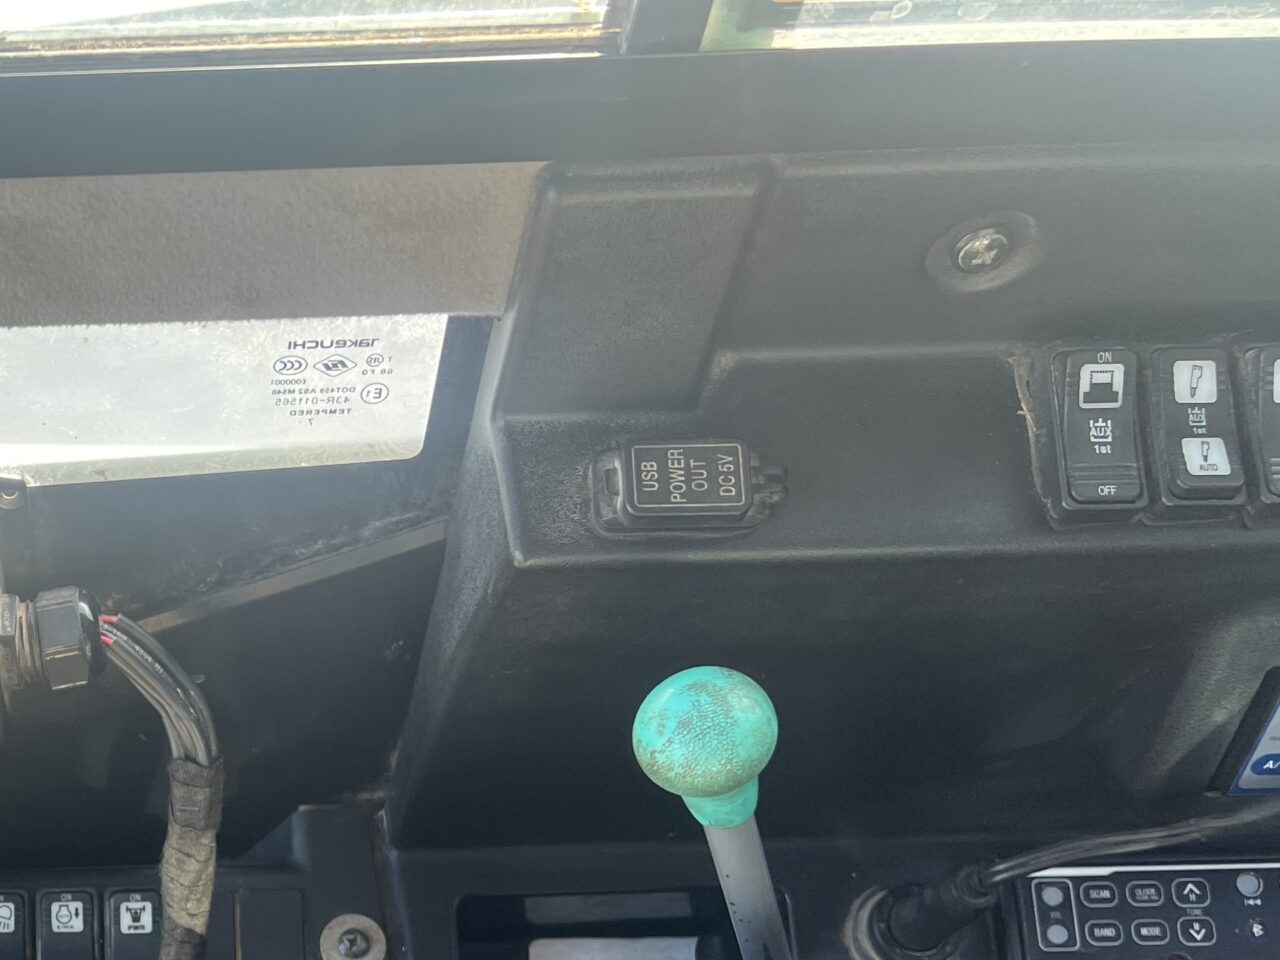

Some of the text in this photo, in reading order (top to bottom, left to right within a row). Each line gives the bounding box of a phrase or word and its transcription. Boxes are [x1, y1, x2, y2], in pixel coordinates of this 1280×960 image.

[1097, 351, 1112, 363] ON
[1188, 414, 1207, 422] AUX
[1089, 426, 1112, 437] AUX
[1093, 444, 1112, 454] 1st
[1199, 463, 1219, 472] AUTO
[640, 461, 659, 491] USB
[667, 448, 687, 503] POWER
[689, 459, 708, 491] OUT
[1097, 485, 1117, 496] OFF
[60, 893, 72, 901] ON
[129, 893, 141, 901] ON
[1088, 888, 1111, 899] SCAN
[1093, 927, 1116, 938] BAND
[1140, 926, 1162, 936] MODE
